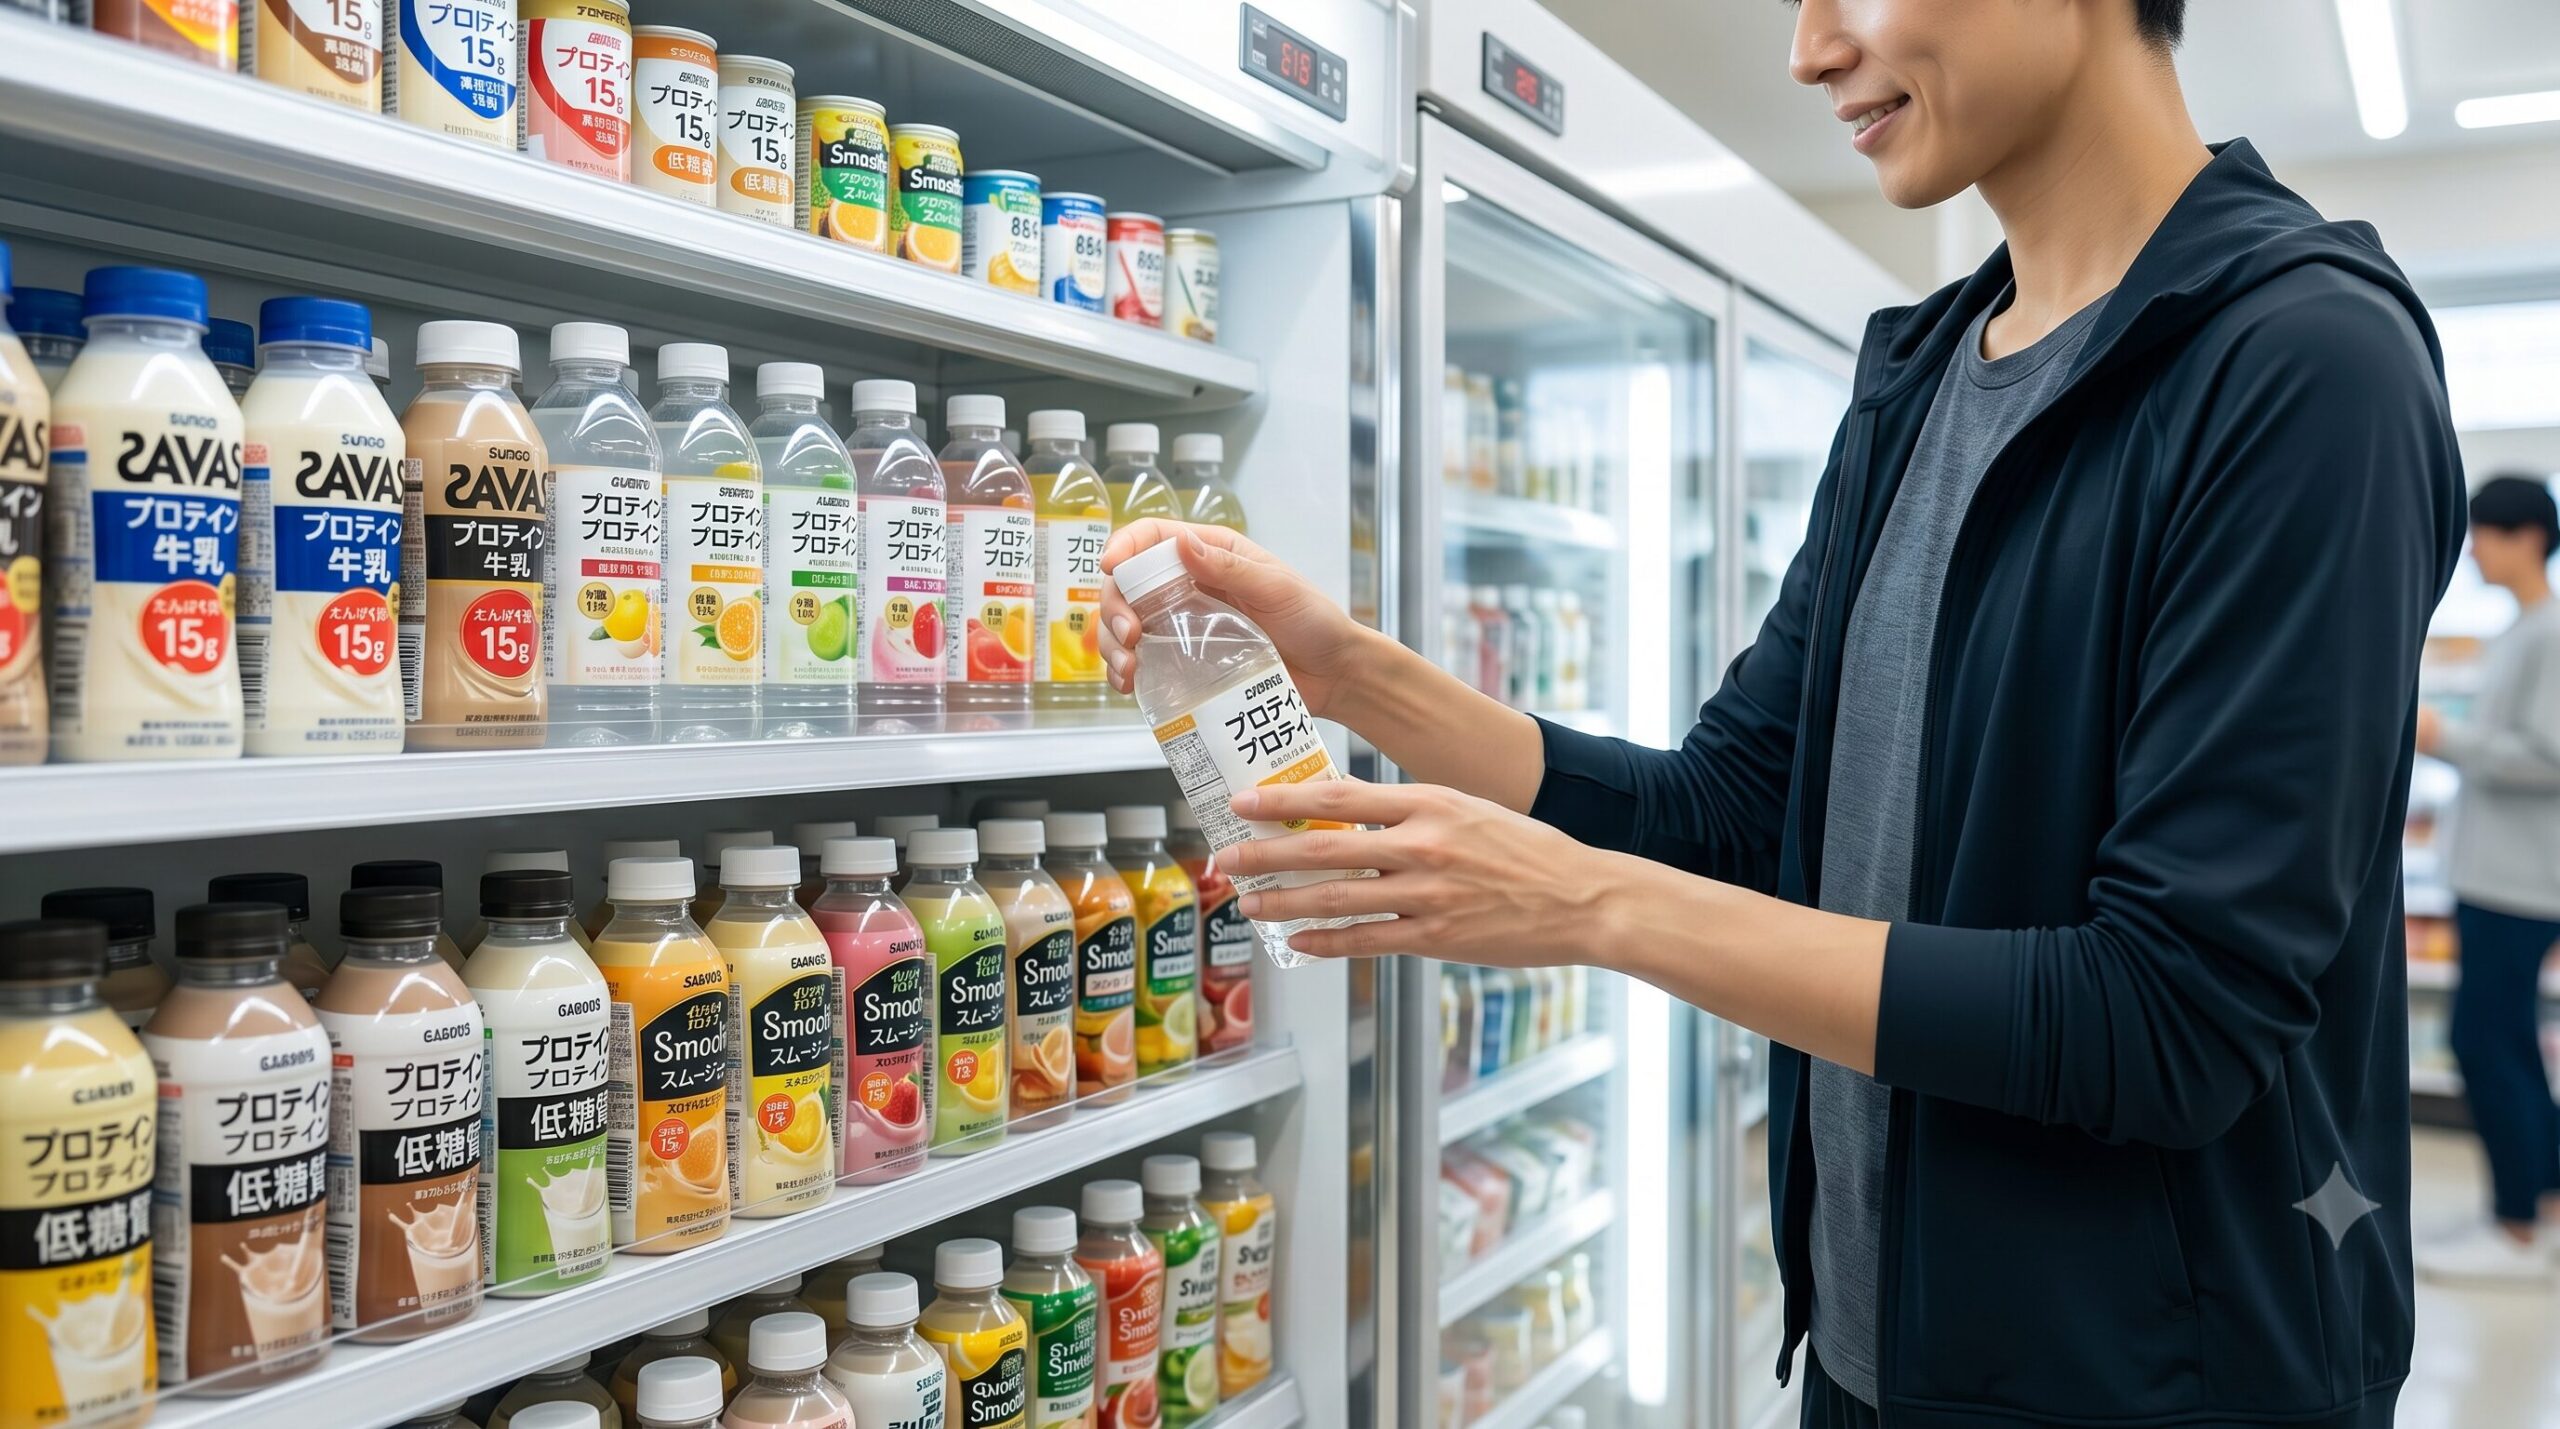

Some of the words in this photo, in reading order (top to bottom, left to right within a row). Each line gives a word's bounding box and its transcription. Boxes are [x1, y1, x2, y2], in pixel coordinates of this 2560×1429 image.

[460, 35, 505, 76] 15g
[556, 47, 631, 81] プロテイン
[584, 76, 624, 116] 15g
[675, 112, 711, 149] 15g
[727, 109, 795, 141] プロテイン
[751, 136, 787, 170] 15g
[124, 496, 238, 534] プロテイン
[581, 492, 660, 520] プロテイン
[302, 511, 402, 545] プロテイン
[452, 520, 545, 551] プロテイン
[581, 519, 660, 545] プロテイン
[153, 533, 225, 577] 牛乳
[327, 549, 391, 584] 牛乳
[483, 552, 531, 578] 牛乳
[158, 619, 218, 663] 15g
[333, 624, 386, 664] 15g
[480, 626, 530, 665] 15g
[522, 1026, 609, 1066] プロテイン
[385, 1053, 484, 1096] プロテイン
[527, 1058, 609, 1091] プロテイン
[216, 1081, 330, 1129] プロテイン
[391, 1087, 482, 1122] プロテイン
[23, 1114, 153, 1169] プロテイン
[223, 1117, 328, 1157] プロテイン
